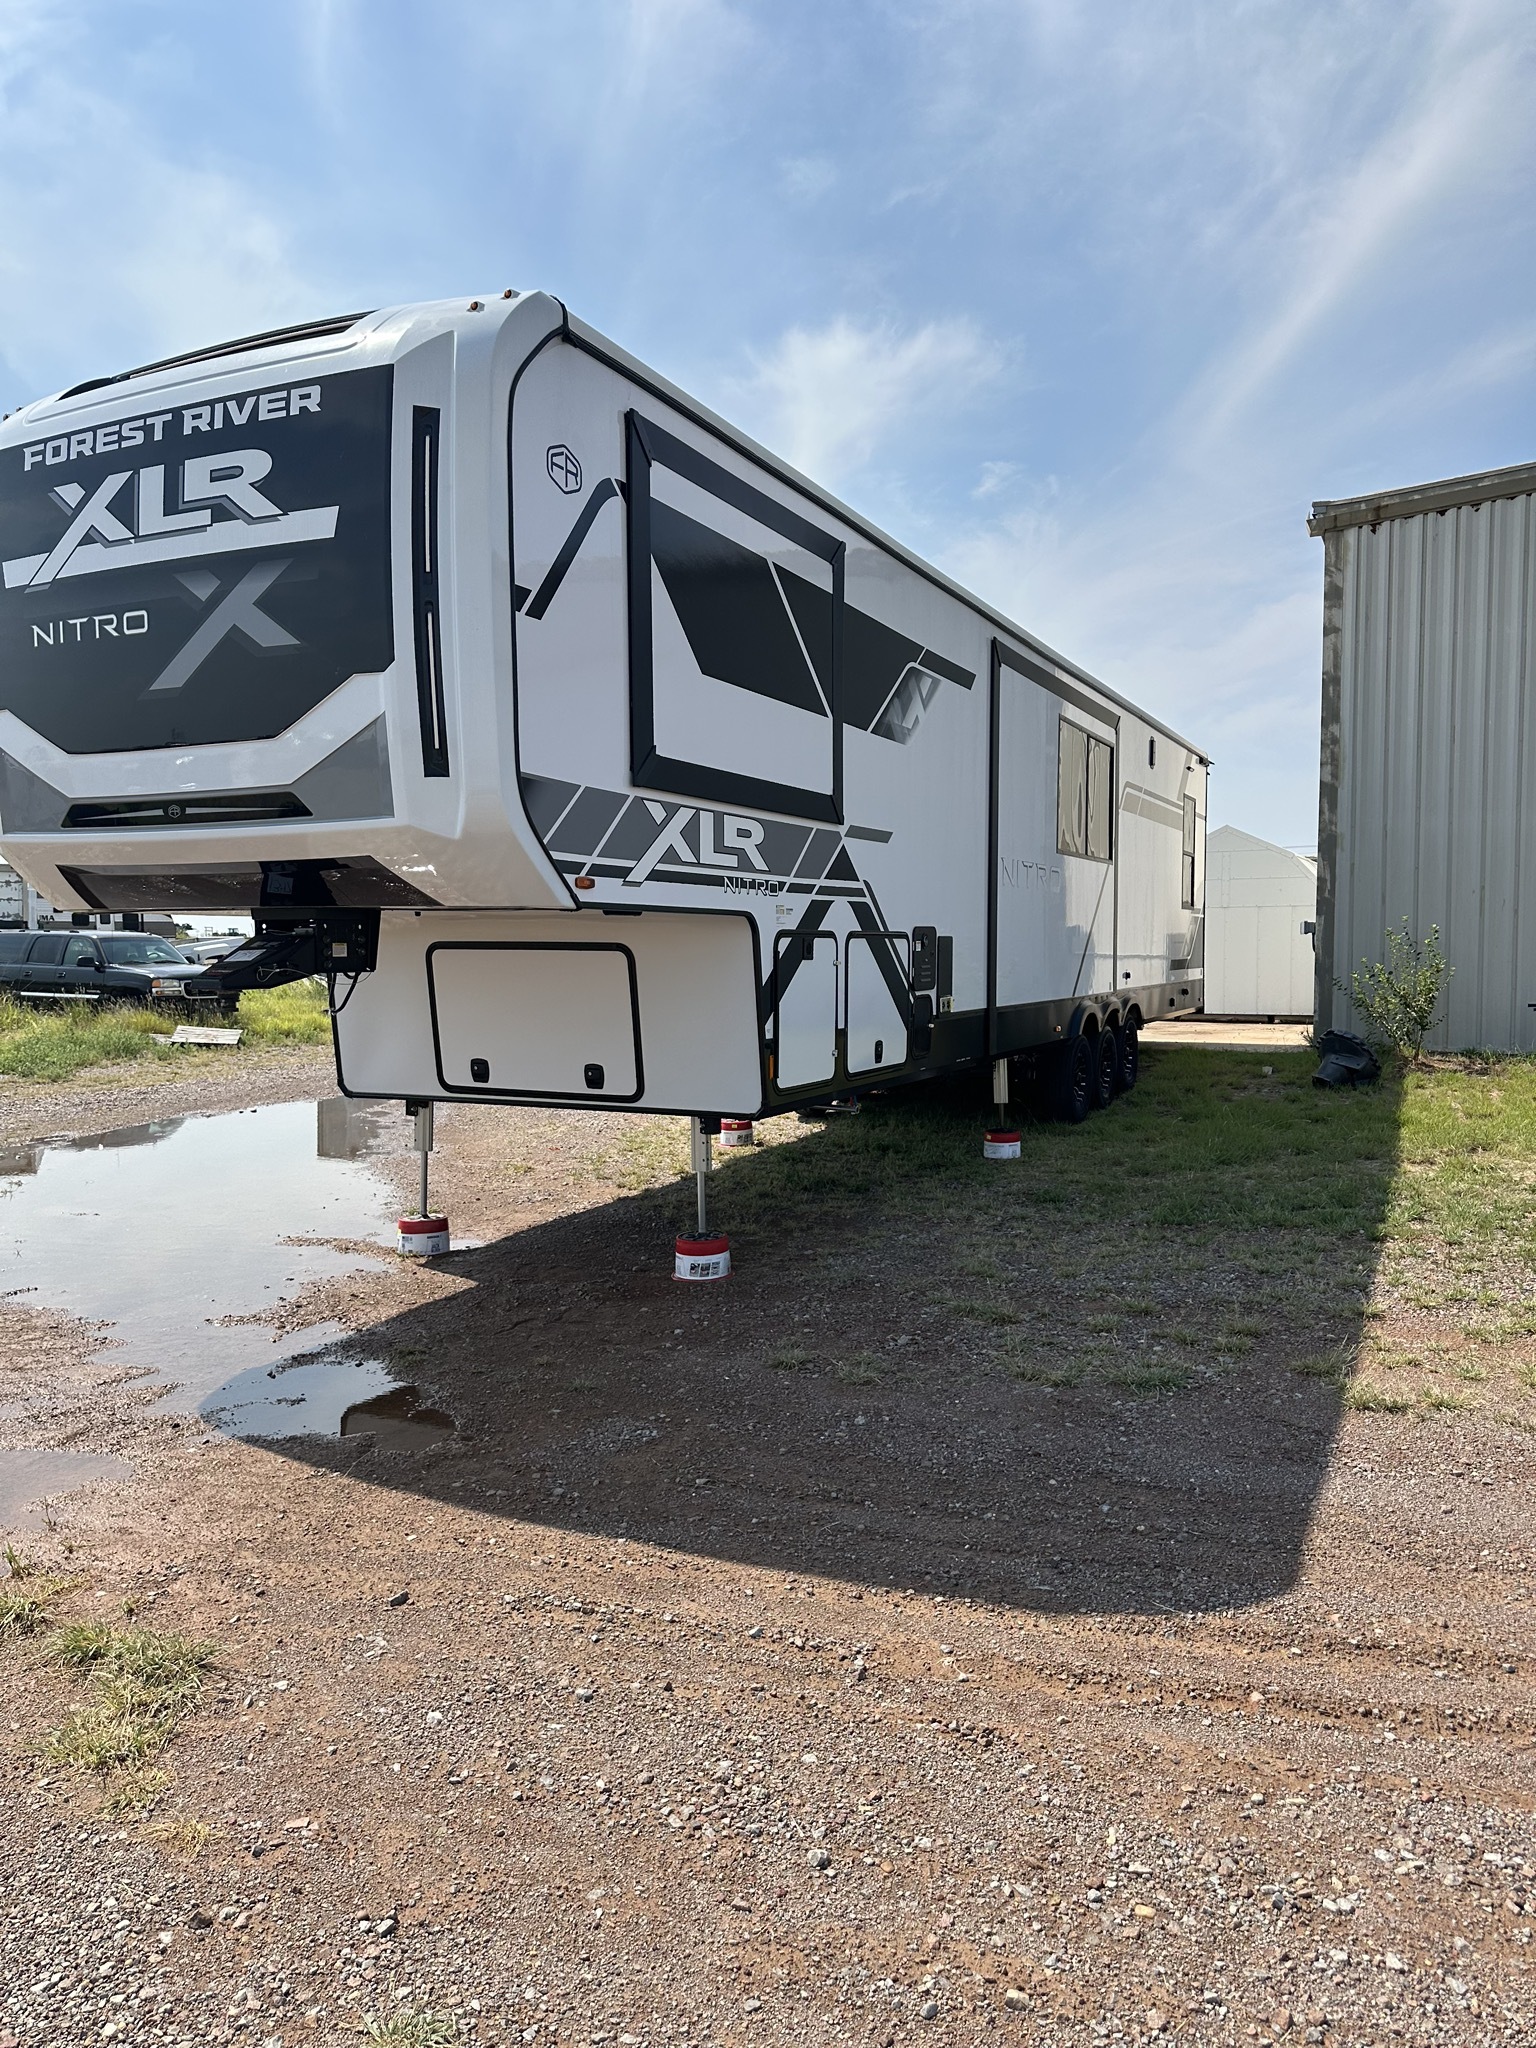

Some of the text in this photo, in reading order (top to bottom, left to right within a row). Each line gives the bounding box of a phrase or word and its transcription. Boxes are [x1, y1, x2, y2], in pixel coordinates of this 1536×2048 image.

[23, 384, 322, 472] FOREST RIVER
[26, 448, 284, 589] XLR
[30, 609, 150, 648] NITRO
[623, 798, 770, 885] XLR
[723, 876, 780, 897] NITRO
[1000, 856, 1061, 894] NITRO
